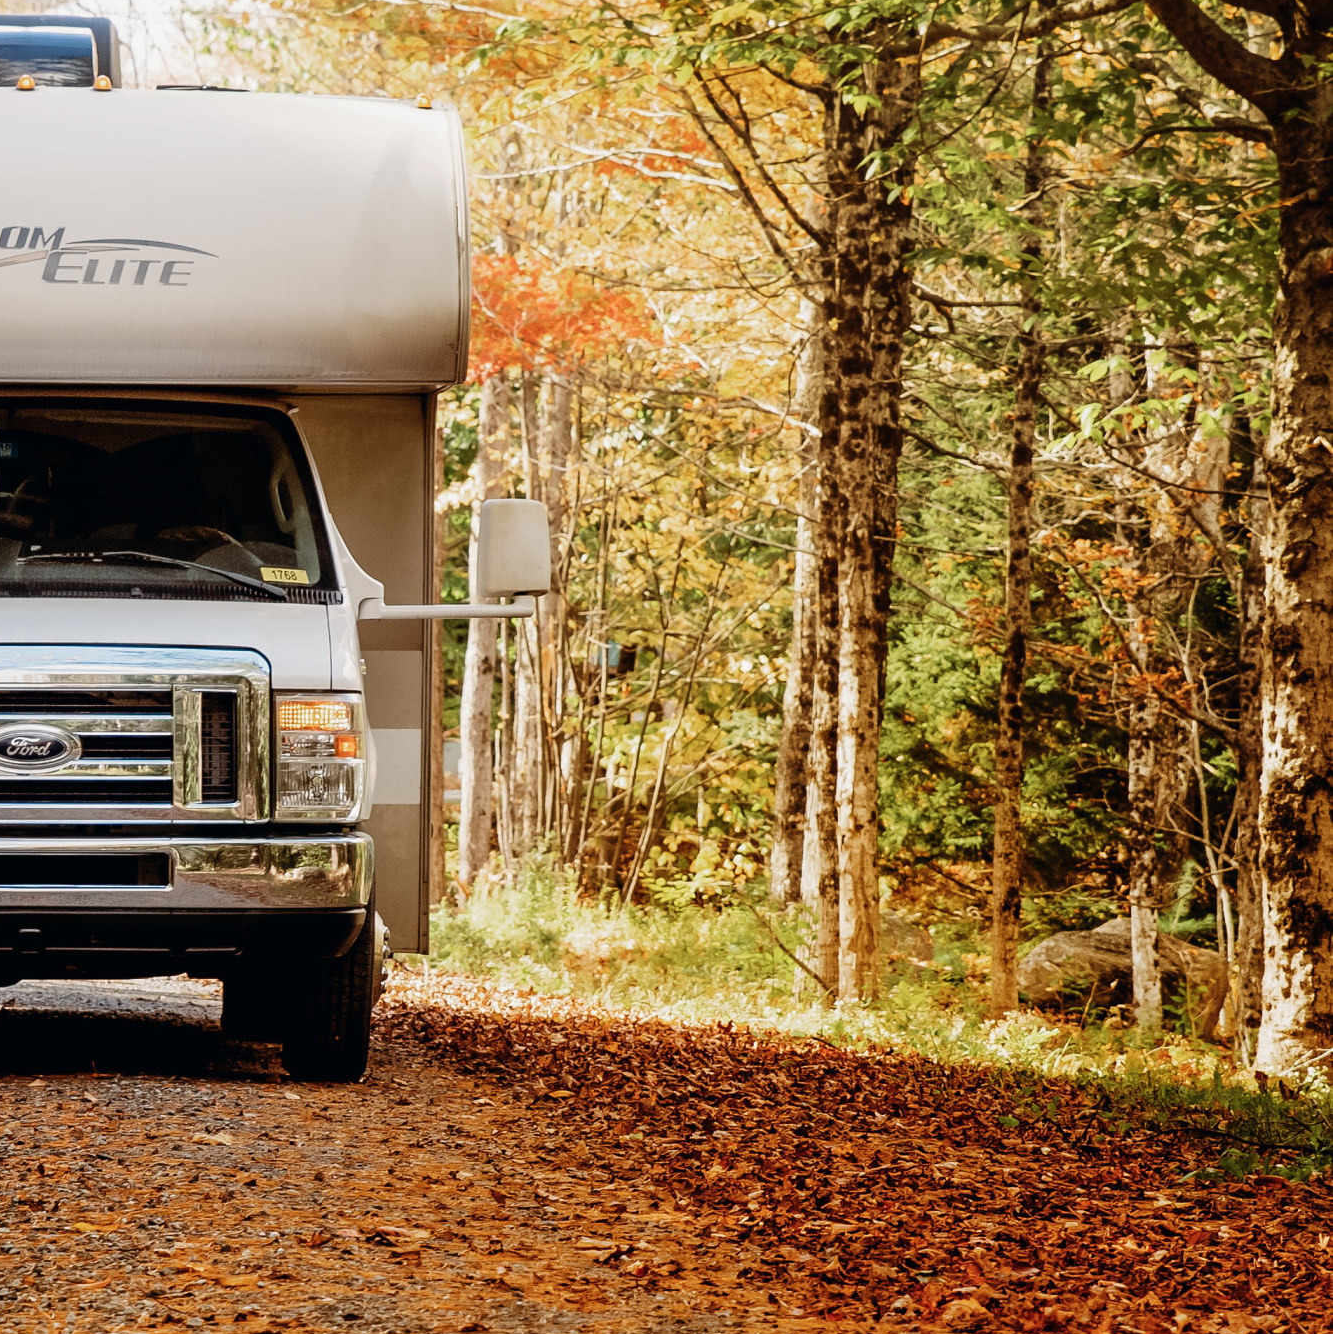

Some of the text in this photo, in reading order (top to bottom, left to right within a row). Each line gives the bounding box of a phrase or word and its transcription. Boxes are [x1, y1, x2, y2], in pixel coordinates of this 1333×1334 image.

[41, 250, 195, 286] ELITE
[271, 569, 298, 581] 1768
[6, 736, 52, 757] Ford
